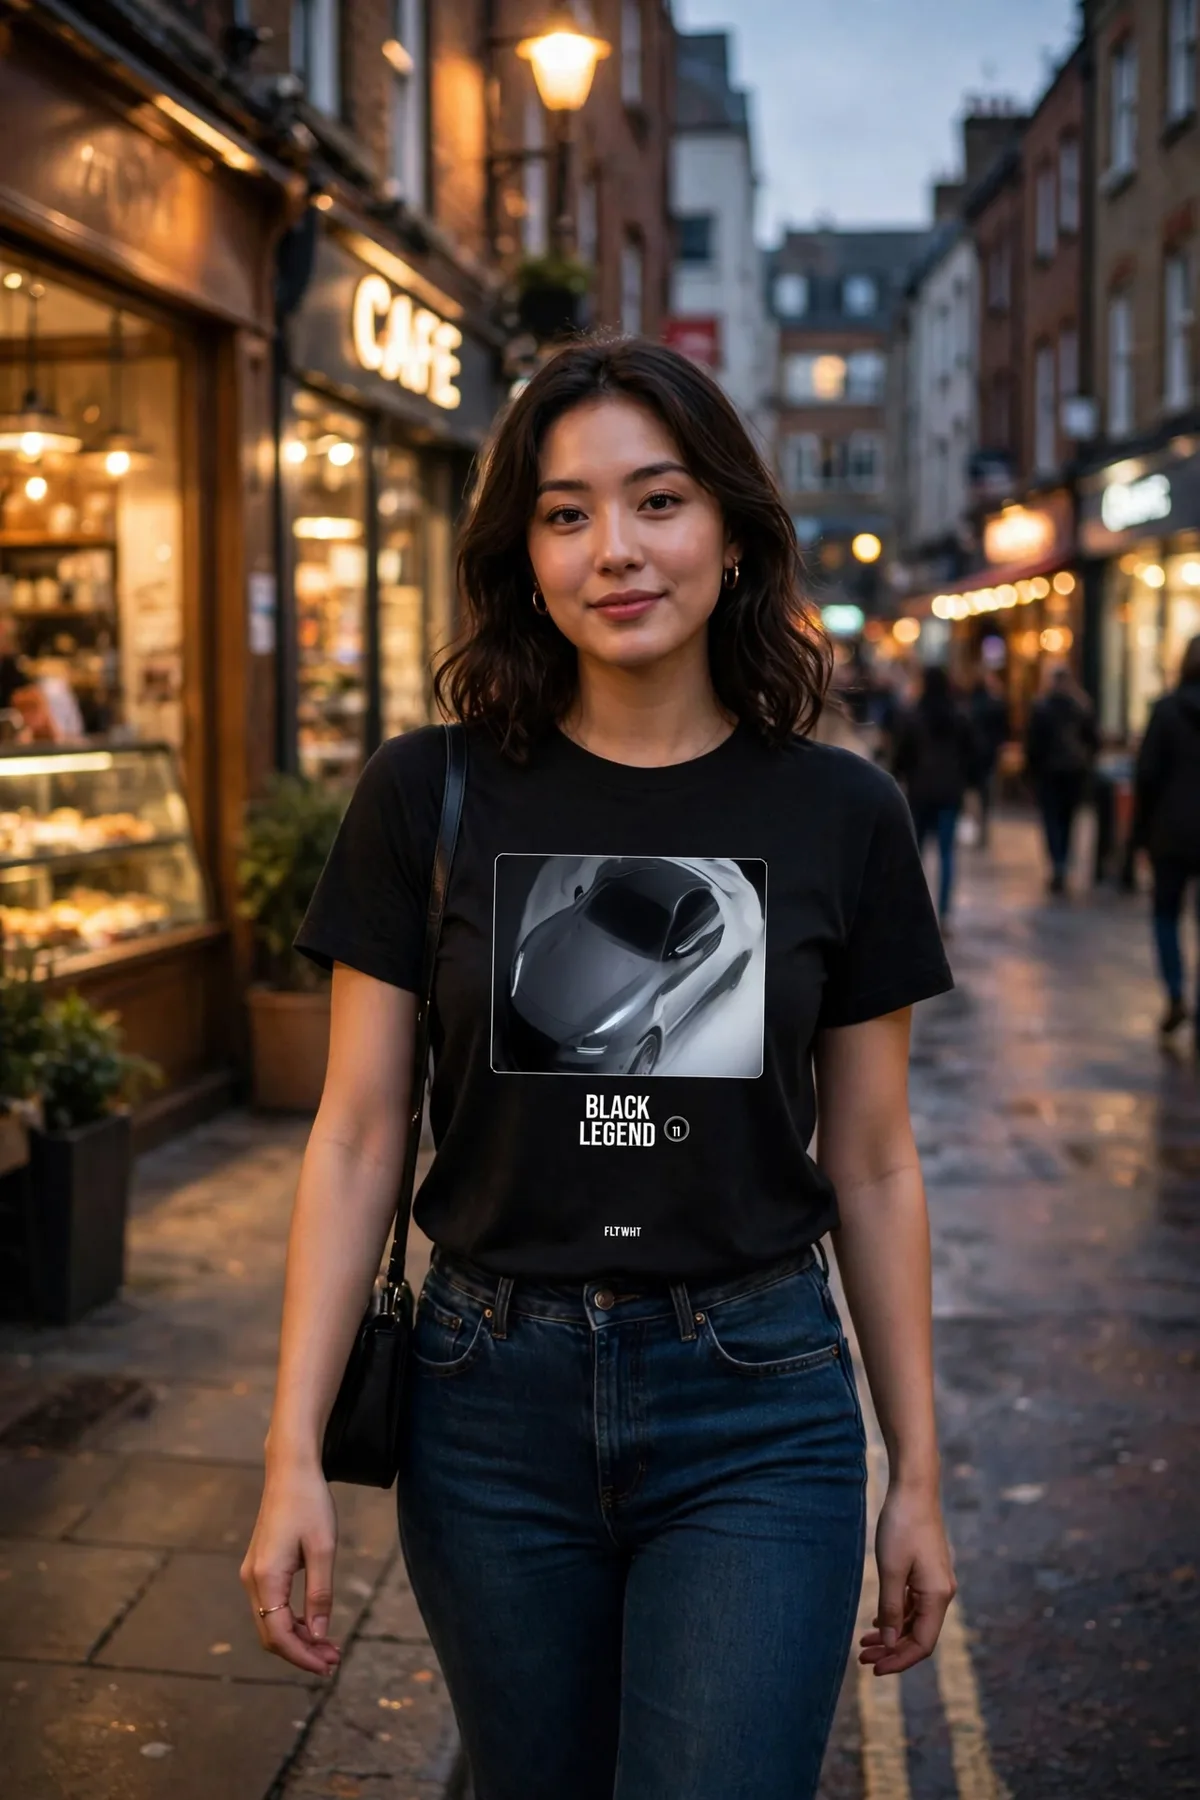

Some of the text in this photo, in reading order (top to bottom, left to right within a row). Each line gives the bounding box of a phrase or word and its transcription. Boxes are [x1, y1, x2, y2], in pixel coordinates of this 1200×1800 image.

[353, 274, 462, 410] CAFE
[586, 1094, 650, 1120] BLACK
[579, 1121, 656, 1147] LEGEND
[671, 1125, 681, 1137] 11
[604, 1225, 642, 1237] FLTWHT
